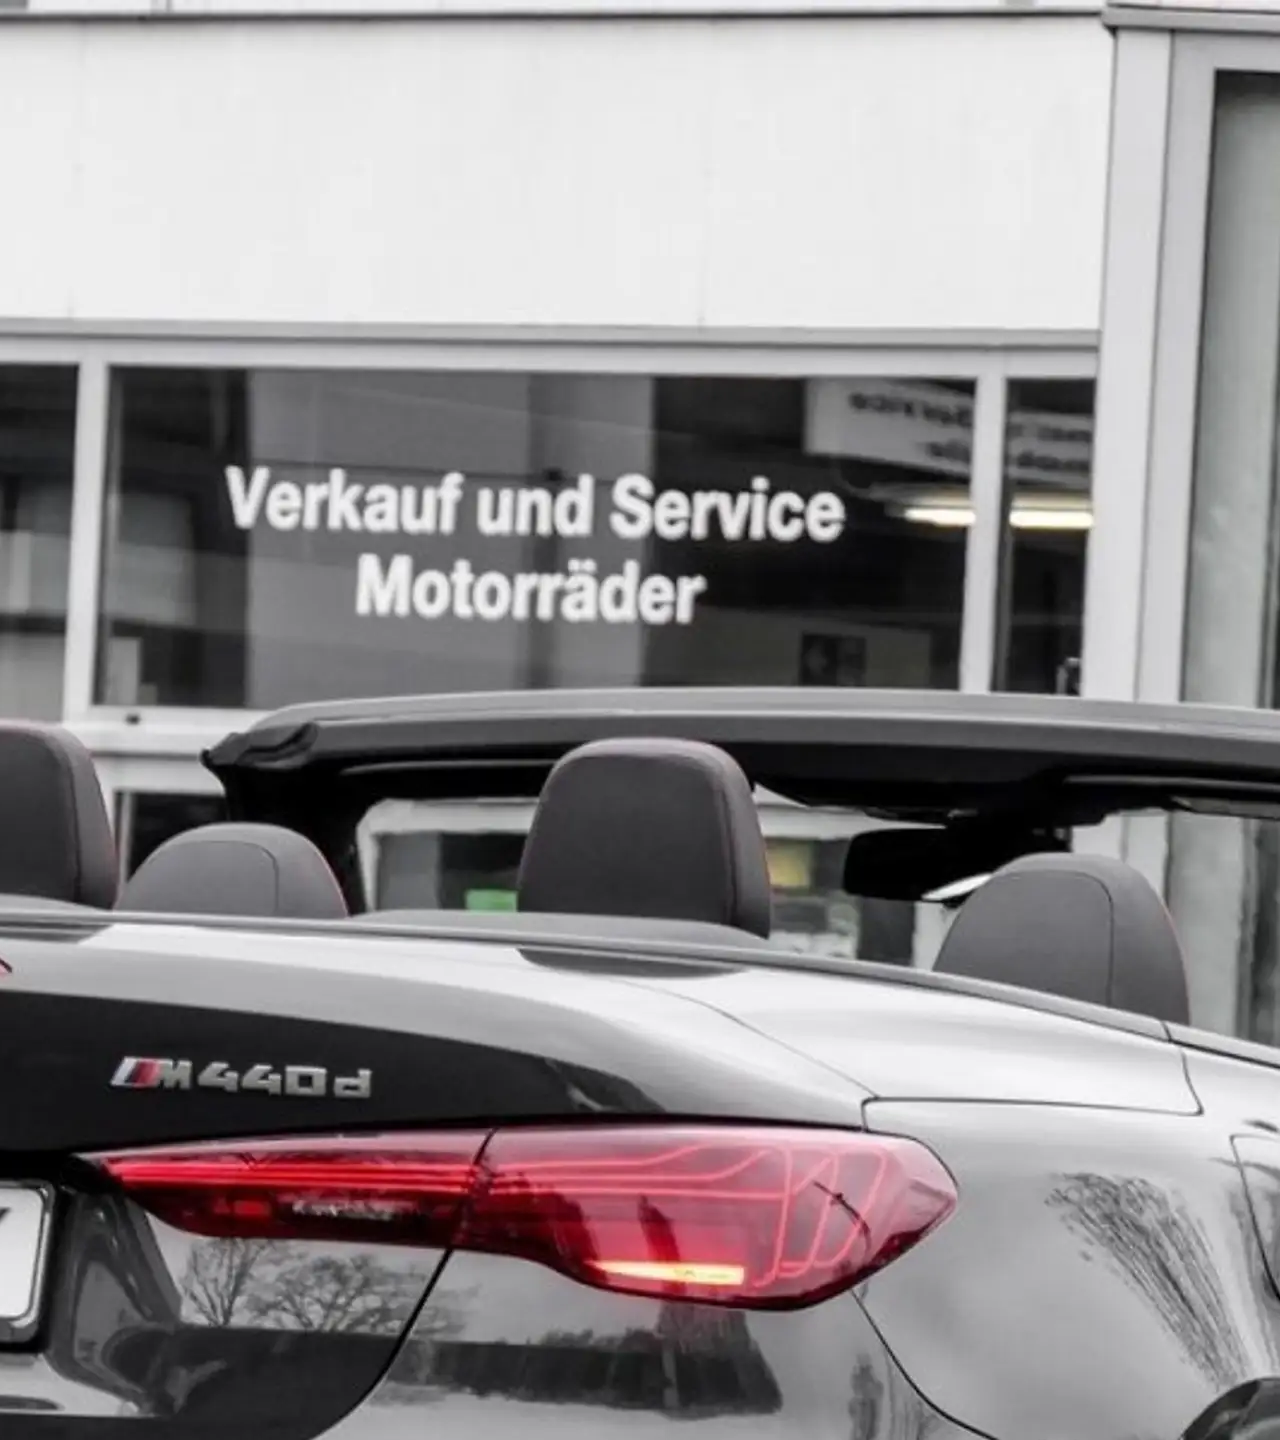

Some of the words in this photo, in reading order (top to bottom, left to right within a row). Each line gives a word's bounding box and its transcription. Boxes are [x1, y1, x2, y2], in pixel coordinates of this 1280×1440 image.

[226, 464, 464, 535] Verkauf
[476, 473, 594, 539] und
[609, 473, 845, 544] Service
[354, 554, 706, 626] Motorräder
